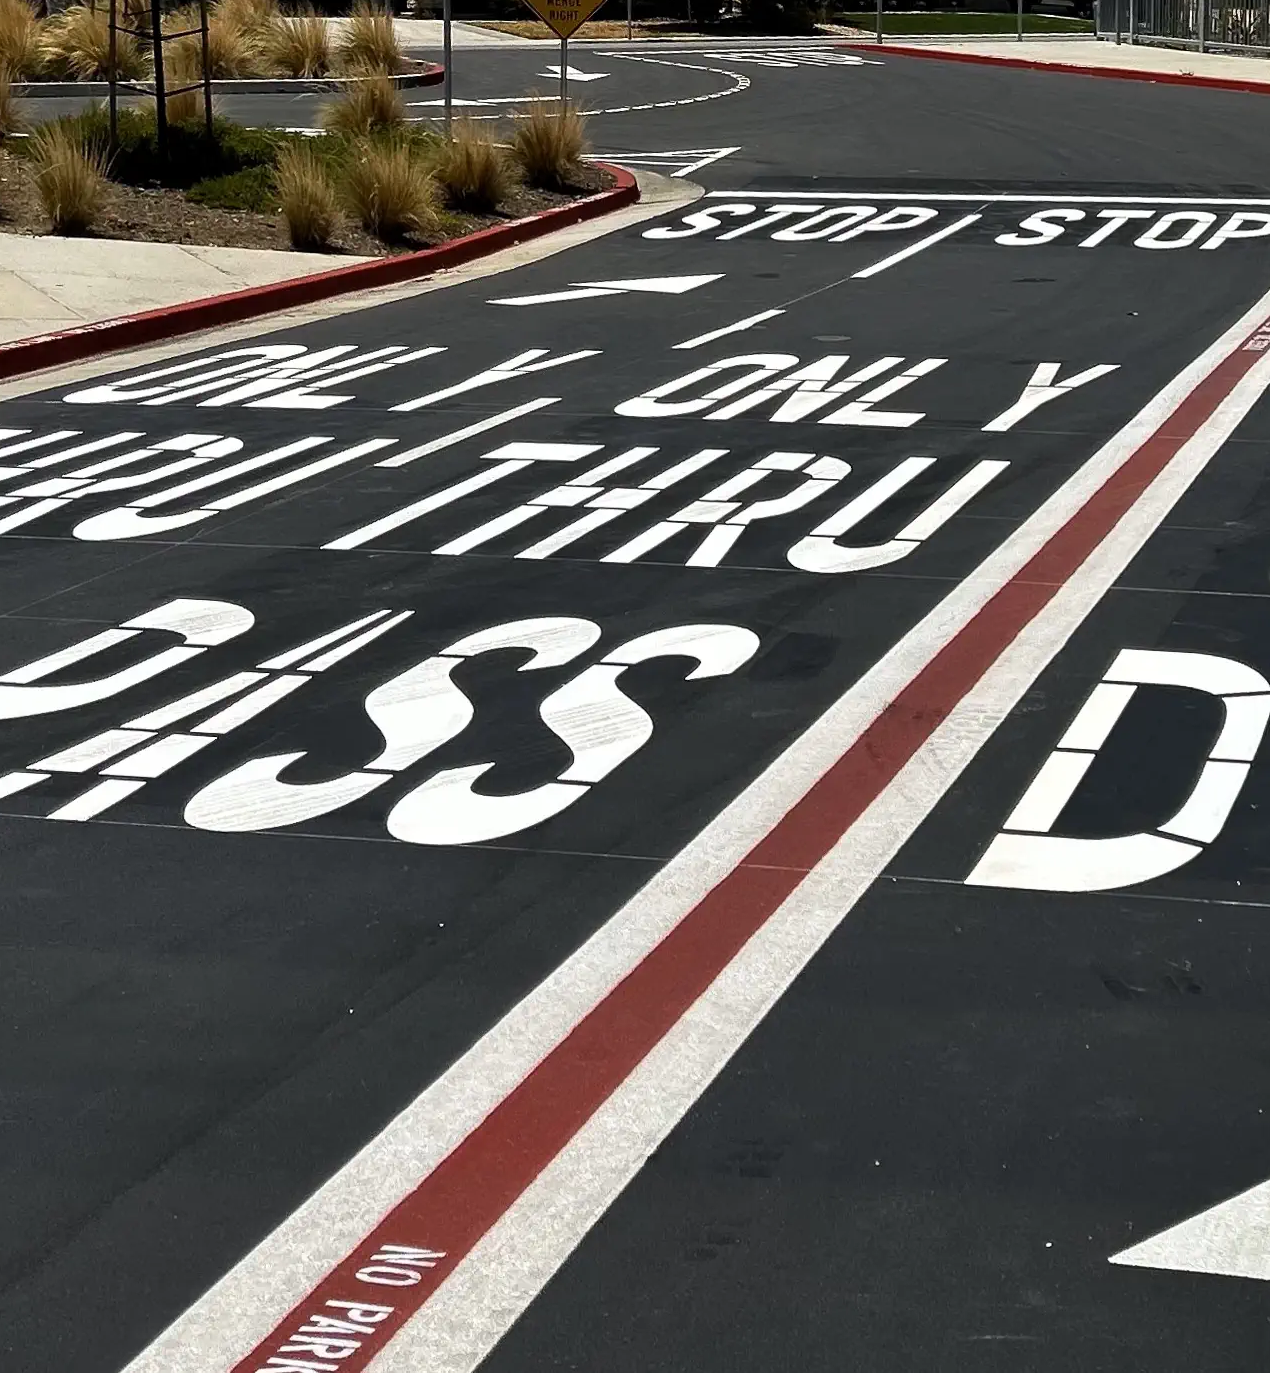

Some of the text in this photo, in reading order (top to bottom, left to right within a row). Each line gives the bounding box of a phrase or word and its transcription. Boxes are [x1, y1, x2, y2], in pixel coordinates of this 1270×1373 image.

[549, 10, 579, 21] RIGHT
[642, 204, 938, 242] STOP
[63, 345, 603, 412] ONLY
[614, 353, 1120, 433] ONLY
[320, 442, 1010, 573] THRU
[355, 1244, 447, 1287] NO
